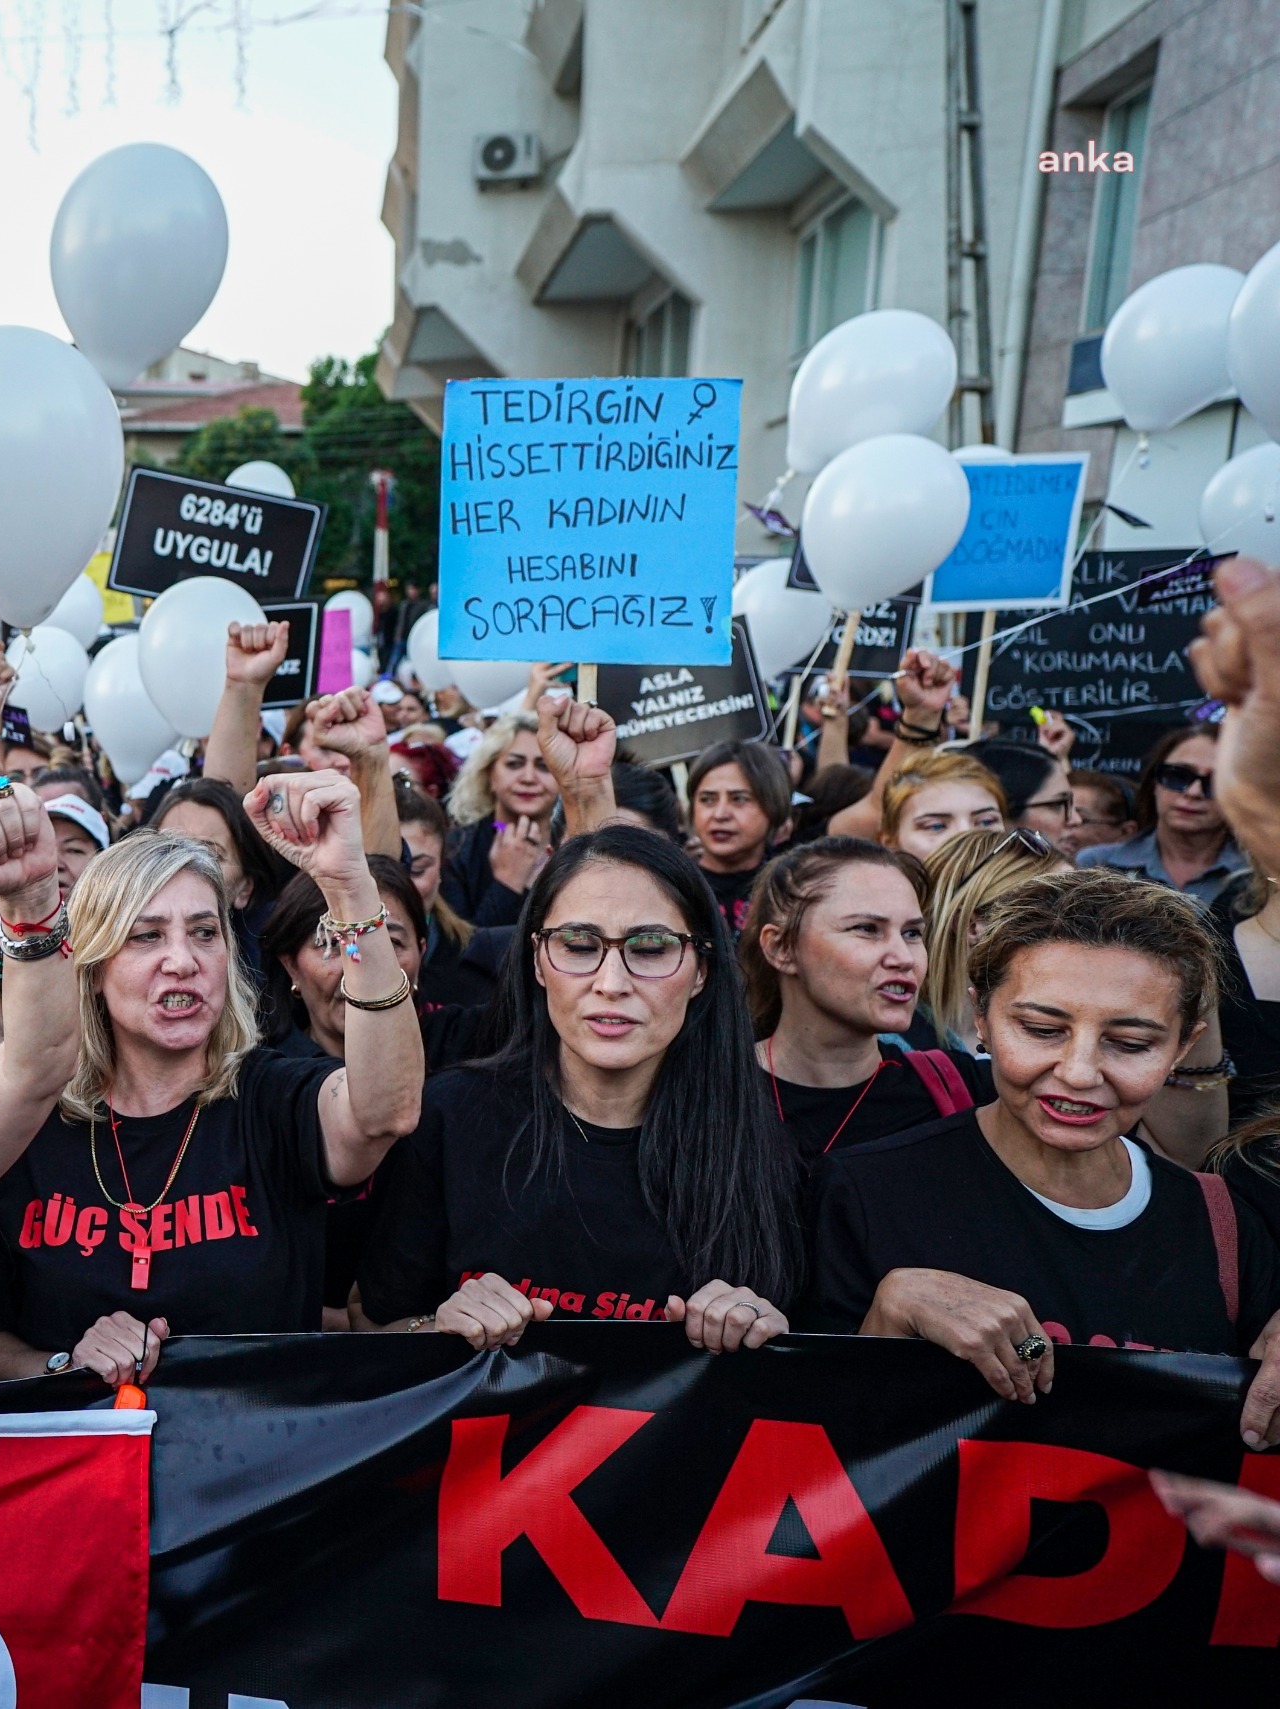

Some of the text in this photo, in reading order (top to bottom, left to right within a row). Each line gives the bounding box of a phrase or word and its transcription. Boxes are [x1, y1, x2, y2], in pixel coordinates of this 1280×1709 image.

[471, 382, 664, 425] TEDİRGİN
[450, 493, 686, 536] HER KADININ
[153, 528, 273, 577] UYGULA!
[507, 553, 637, 584] HESABINI
[1089, 622, 1146, 645] ONU
[630, 685, 706, 717] YALNIZ
[639, 668, 694, 695] ASLA
[616, 693, 755, 739] RÜMEYECEKSİN!
[19, 1184, 258, 1257] GÜÇ SENDE
